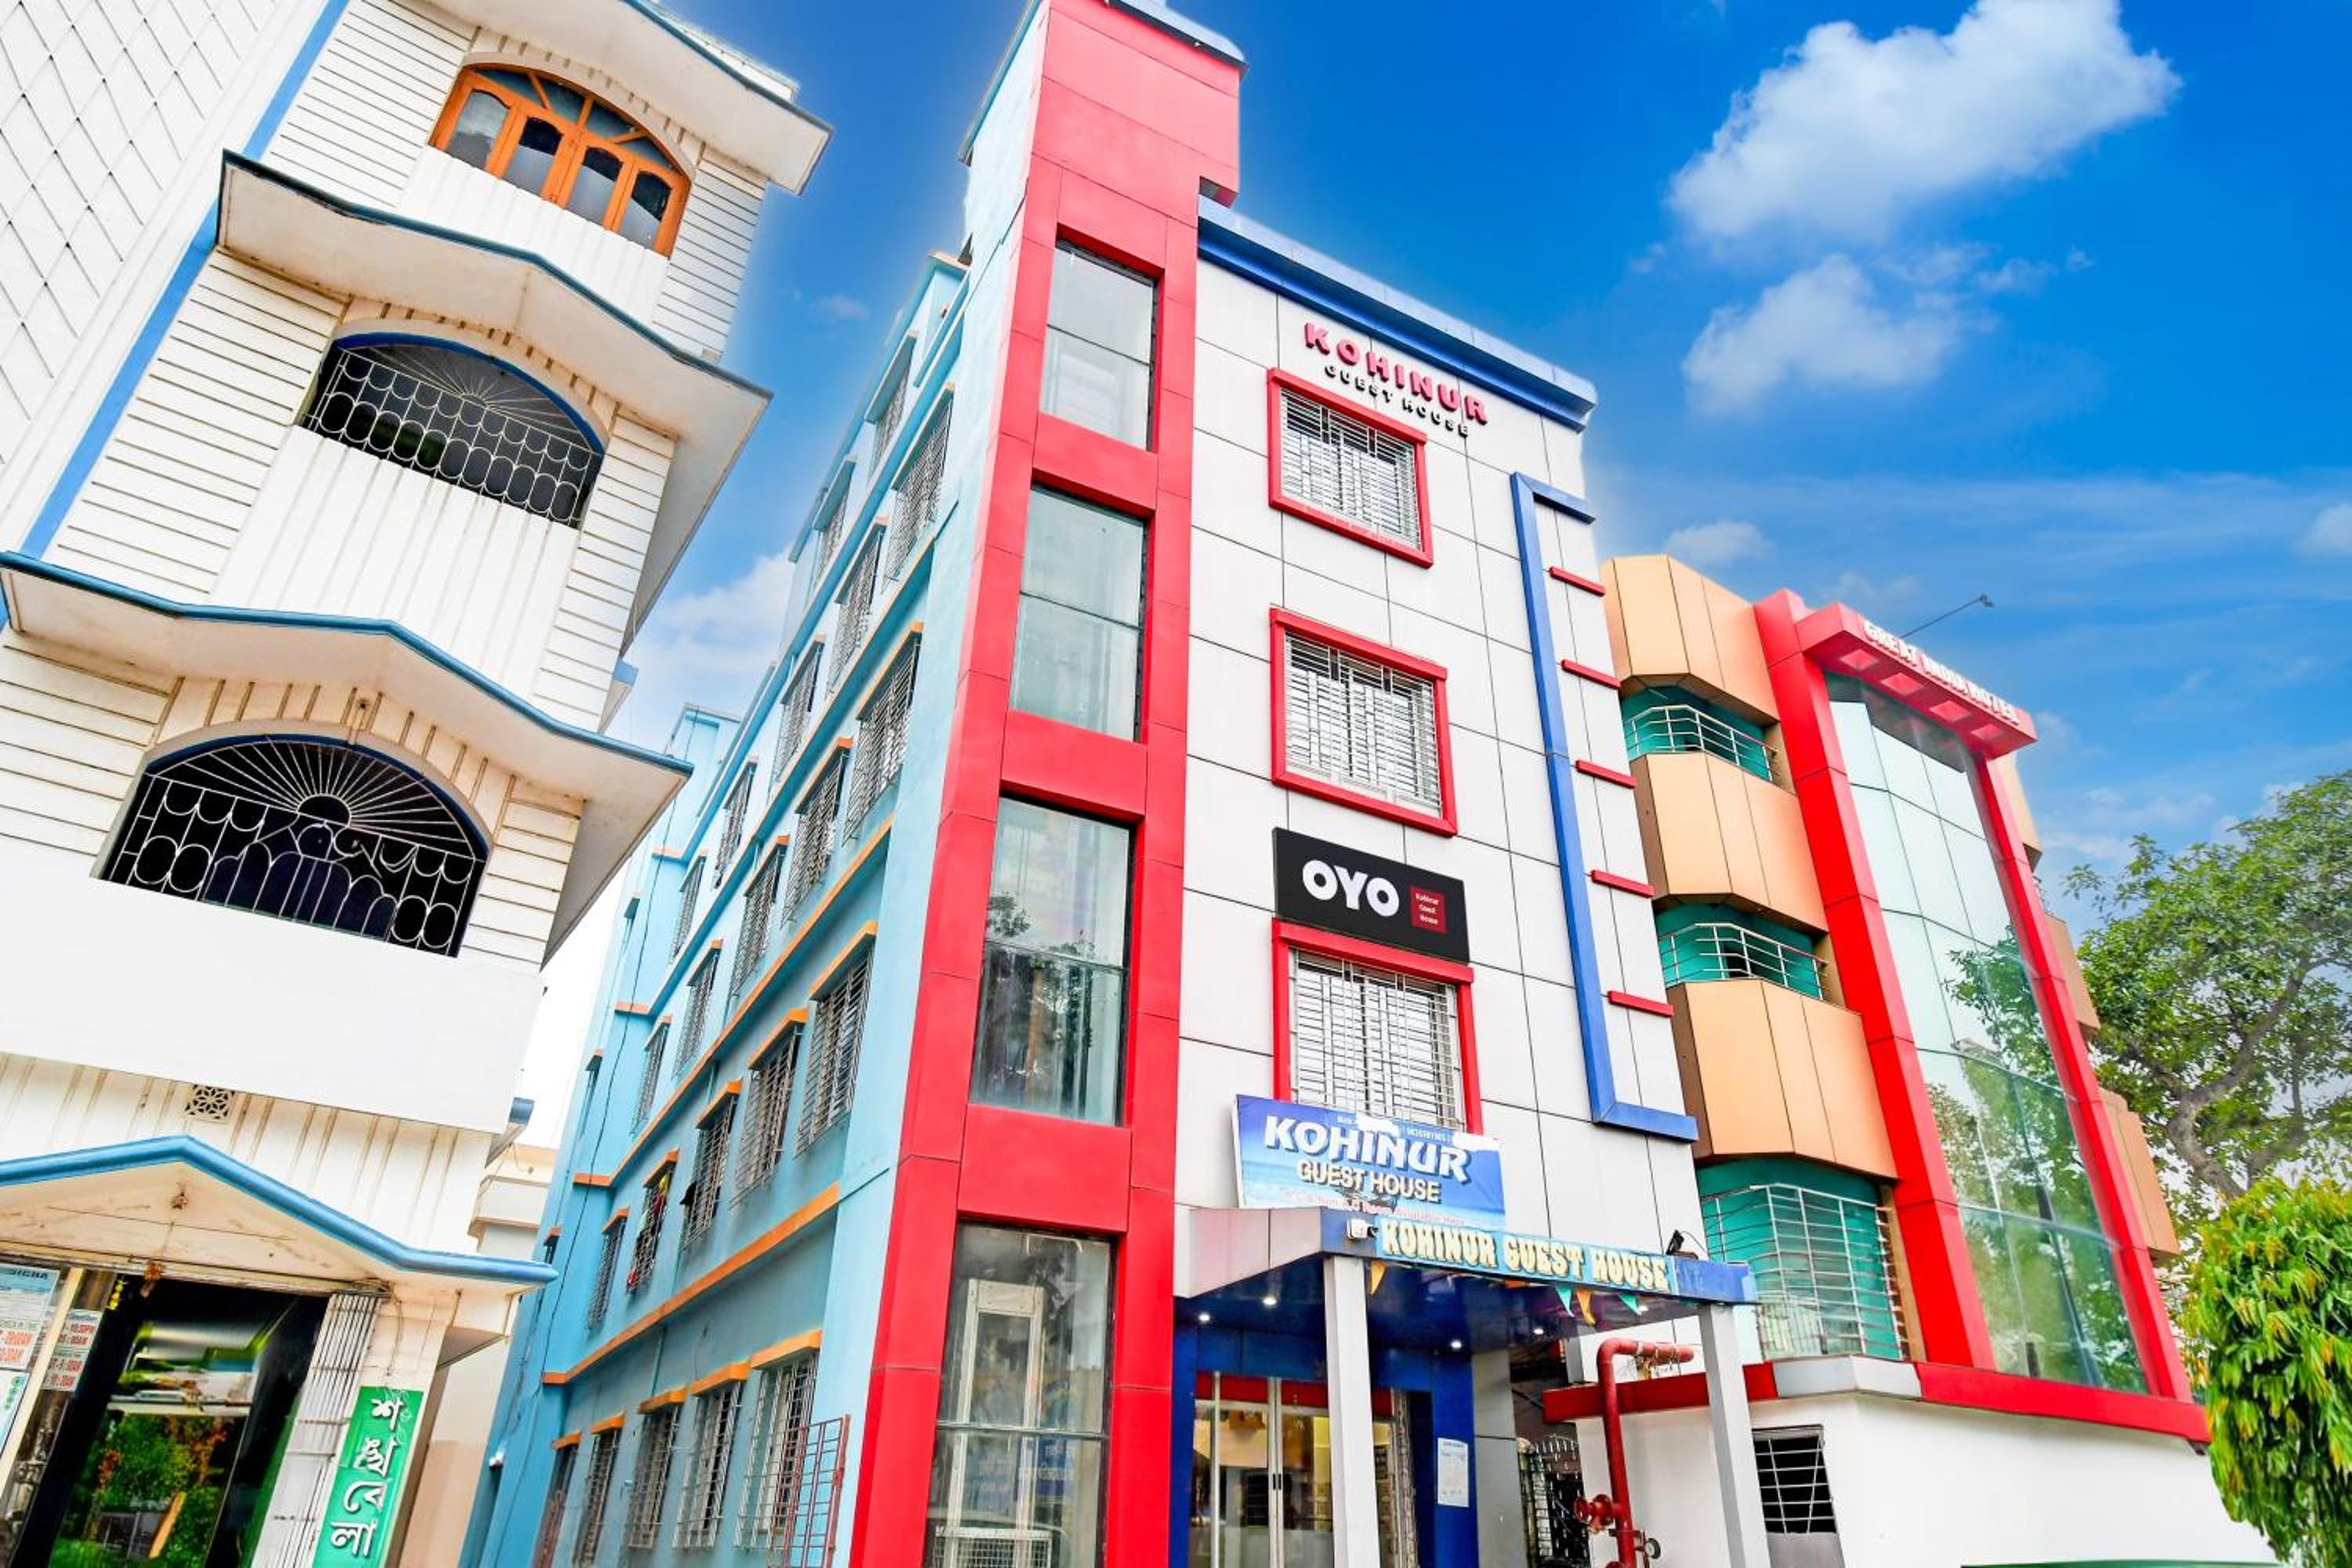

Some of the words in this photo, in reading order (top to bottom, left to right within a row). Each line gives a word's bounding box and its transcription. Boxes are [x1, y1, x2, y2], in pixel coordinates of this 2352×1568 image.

[1304, 322, 1487, 425] KOHINUR
[1325, 365, 1393, 403] GUEST
[1403, 397, 1468, 437] HOUSE
[1302, 859, 1399, 916] OYO
[1263, 1115, 1471, 1183] KOHINUR
[1298, 1160, 1369, 1193] GUEST
[1370, 1170, 1441, 1203] HOUSE
[1382, 1220, 1497, 1268] KOHINUR
[1504, 1234, 1585, 1279] GUEST
[1592, 1245, 1671, 1290] HOUSE
